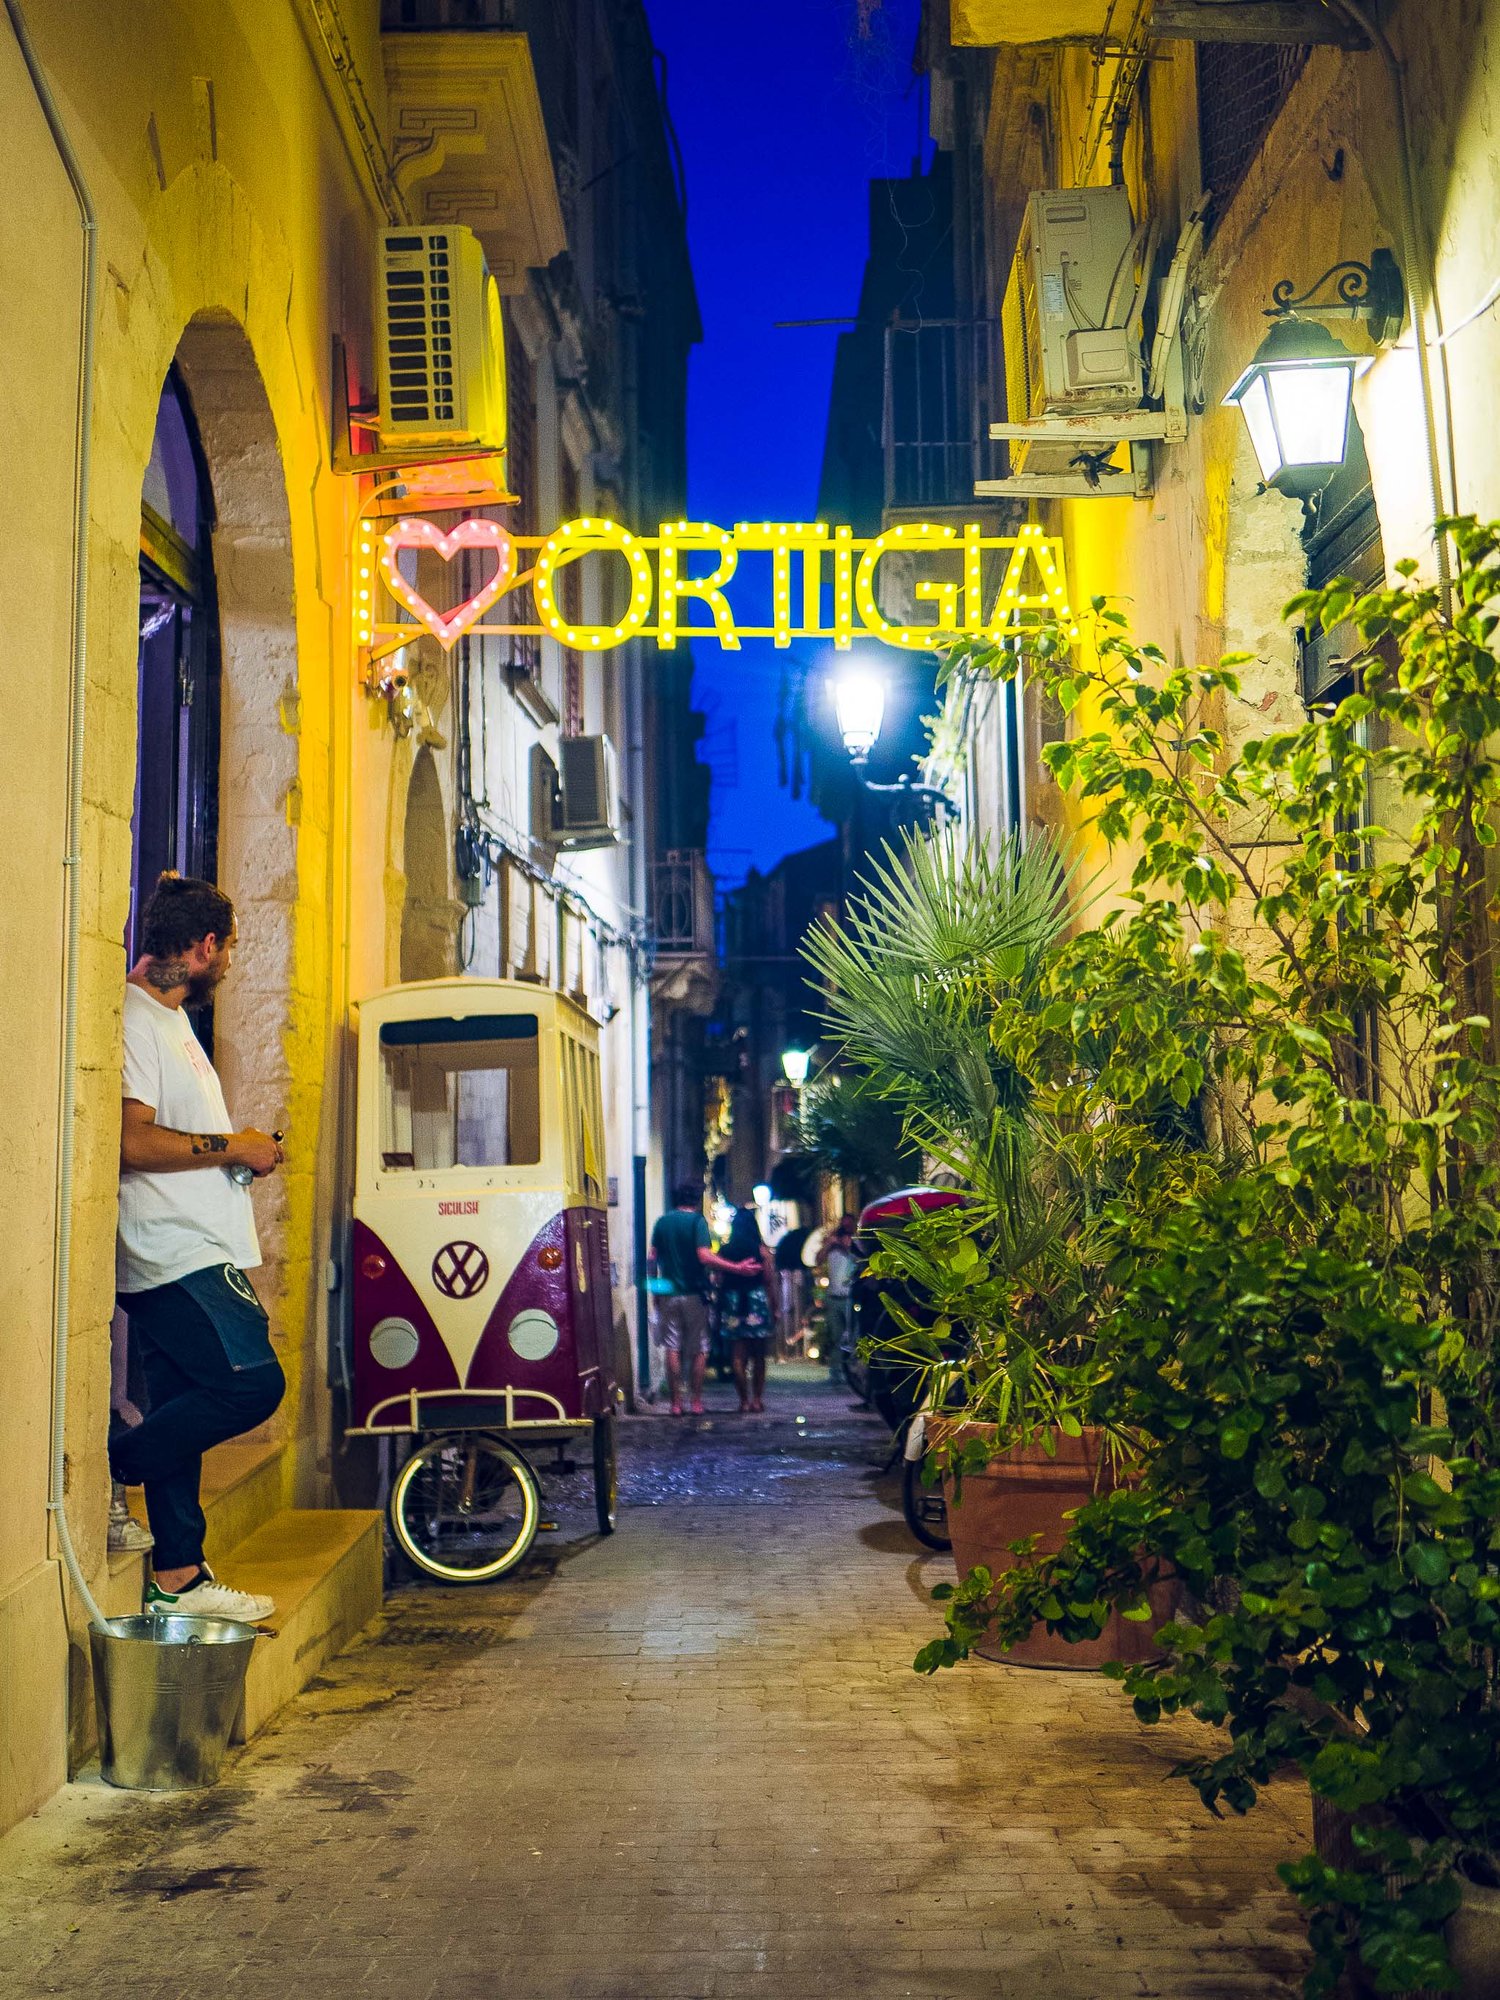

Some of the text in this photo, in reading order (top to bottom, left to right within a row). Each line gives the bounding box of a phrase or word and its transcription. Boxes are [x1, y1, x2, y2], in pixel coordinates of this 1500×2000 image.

[533, 517, 1081, 651] ORTIGIA
[438, 1201, 480, 1216] SICULISH
[432, 1240, 489, 1299] VW
